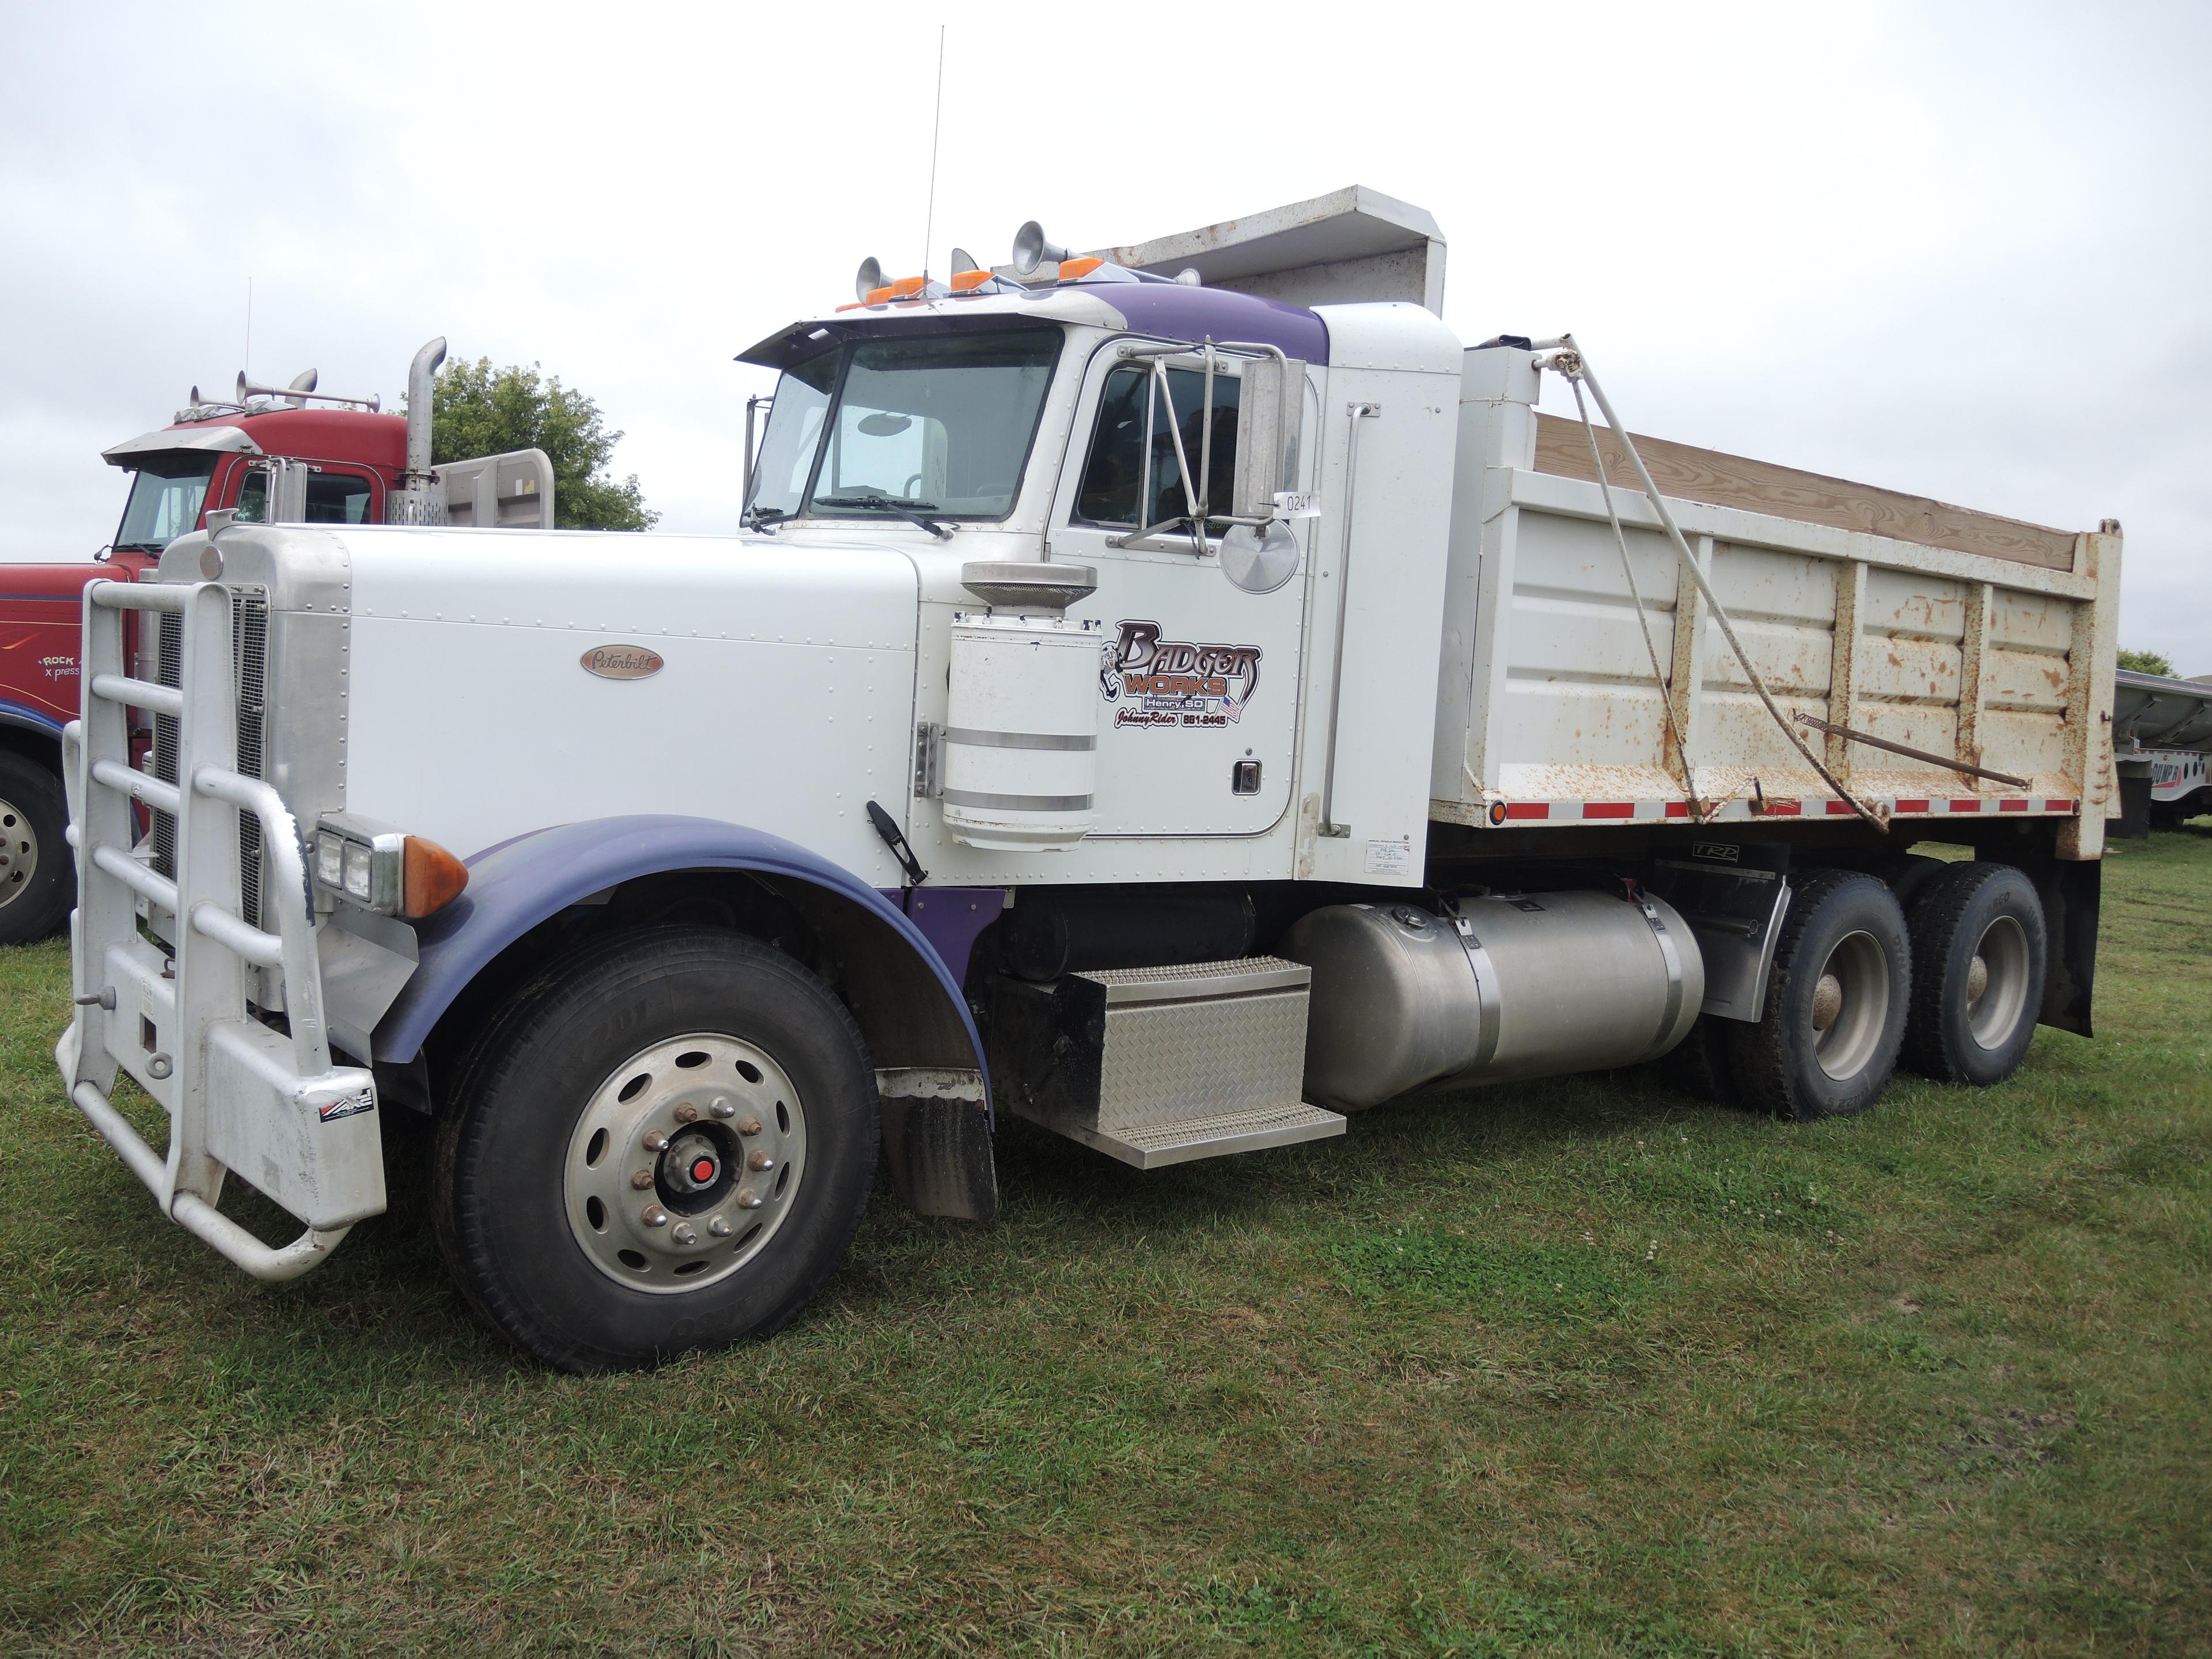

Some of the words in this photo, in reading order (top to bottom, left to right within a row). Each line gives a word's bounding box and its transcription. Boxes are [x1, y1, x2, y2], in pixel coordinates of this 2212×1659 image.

[1287, 495, 1311, 511] 0241
[43, 656, 74, 666] ROCK
[592, 650, 658, 670] Peterbilt
[1118, 622, 1262, 703] BADGER
[1124, 673, 1228, 697] WORKS
